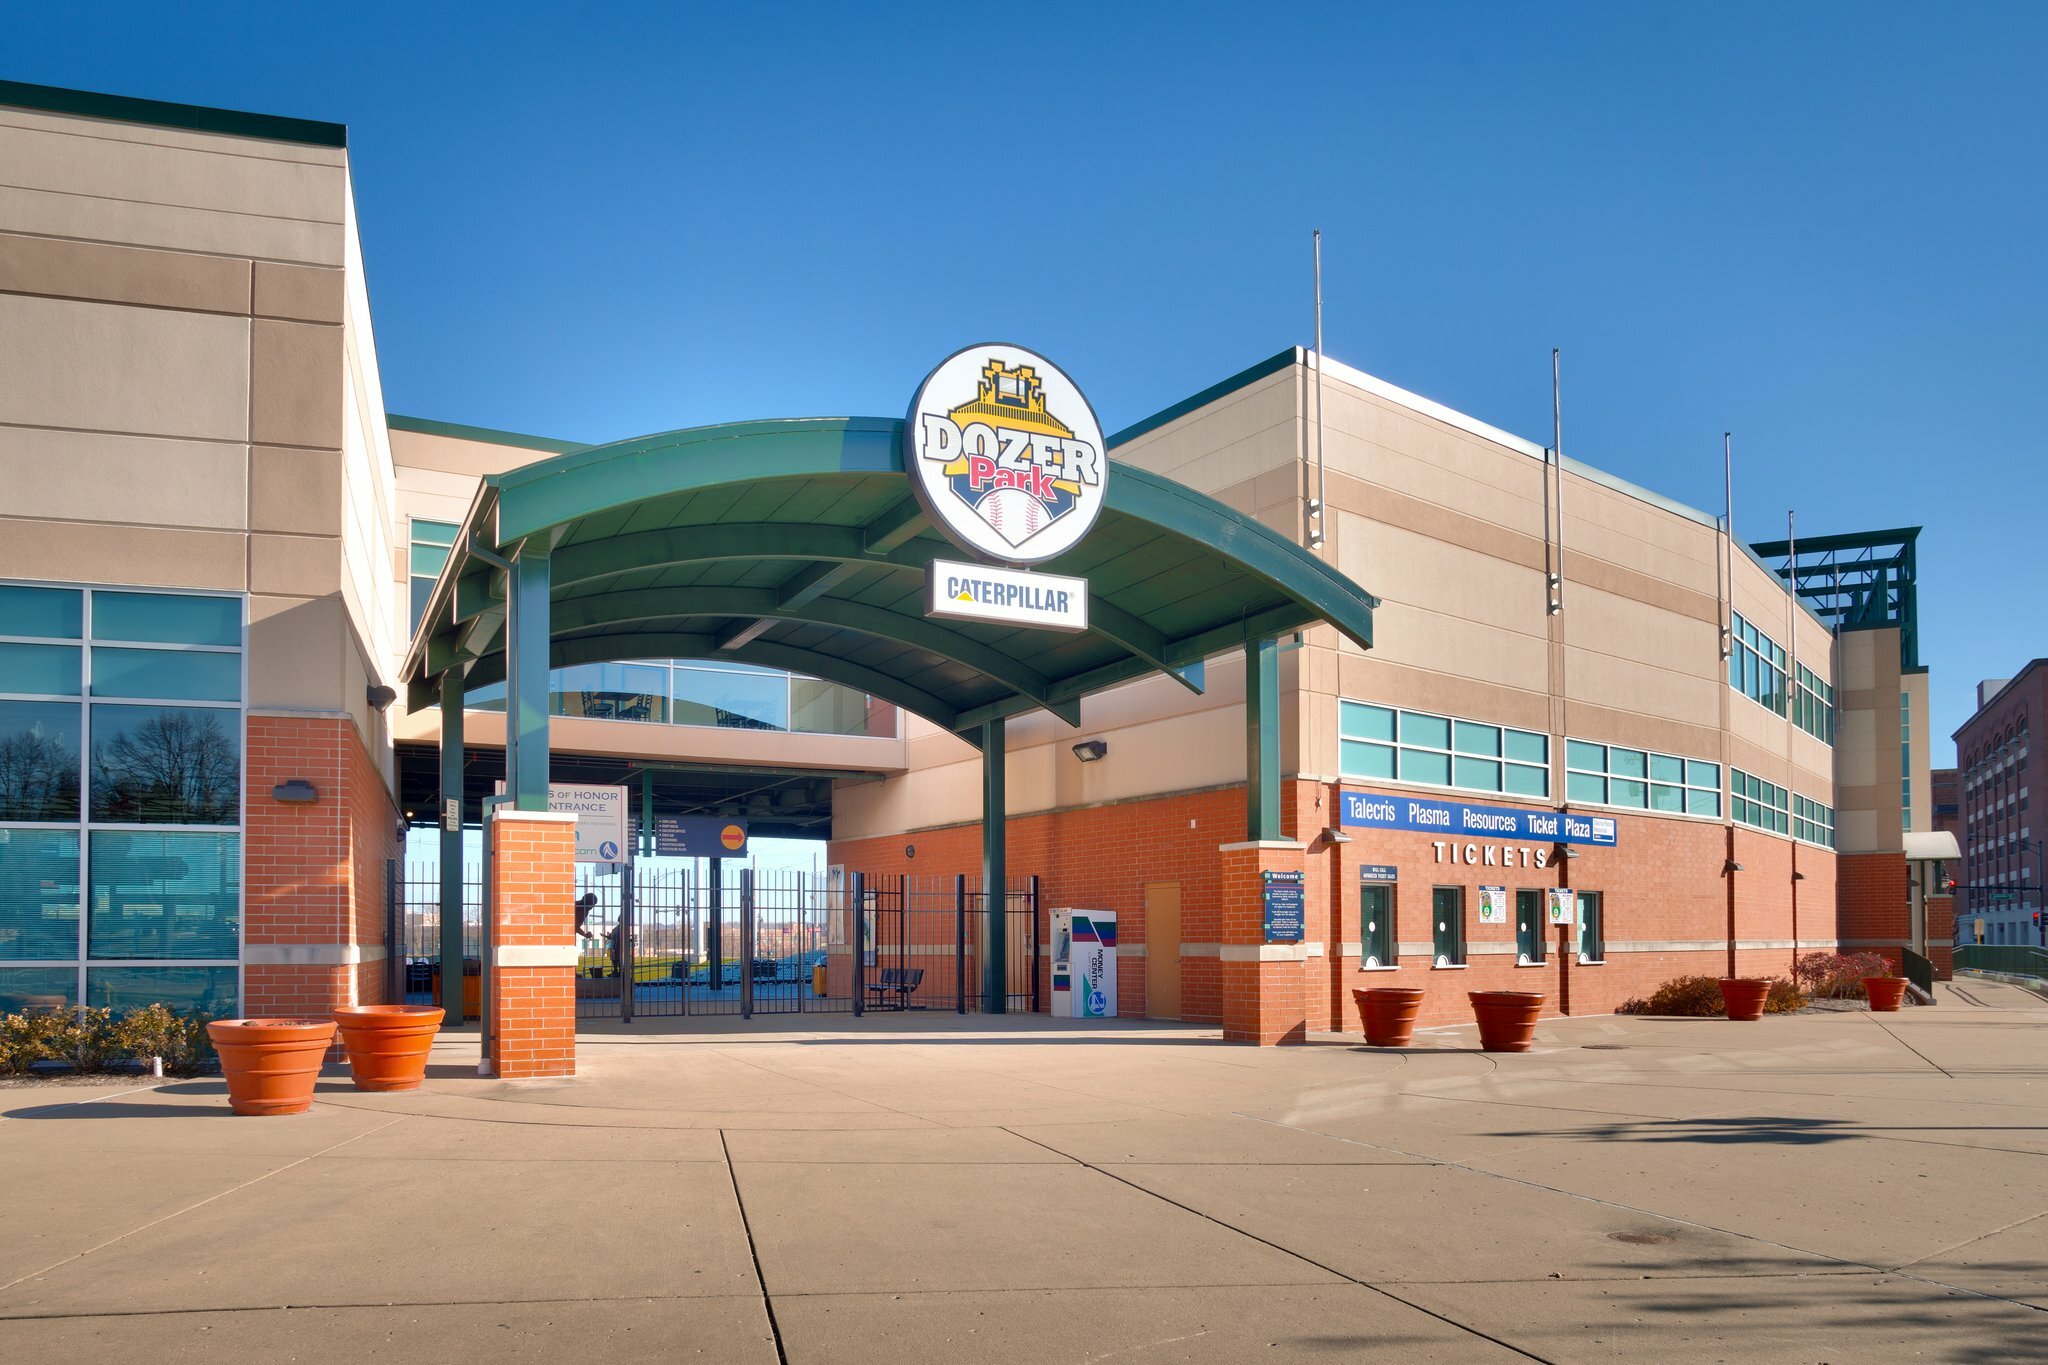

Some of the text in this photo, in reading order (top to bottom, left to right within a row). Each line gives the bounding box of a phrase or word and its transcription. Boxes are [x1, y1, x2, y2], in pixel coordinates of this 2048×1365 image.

[922, 412, 1099, 487] DOZER
[969, 454, 1057, 500] Park
[947, 576, 1069, 613] CATERPILLAR
[549, 802, 607, 812] NTRANCE
[557, 791, 571, 799] OF
[574, 791, 618, 801] HONOR
[1348, 796, 1590, 838] Talecris Plasma Resources Ticket Plaza
[1433, 841, 1546, 868] TICKETS
